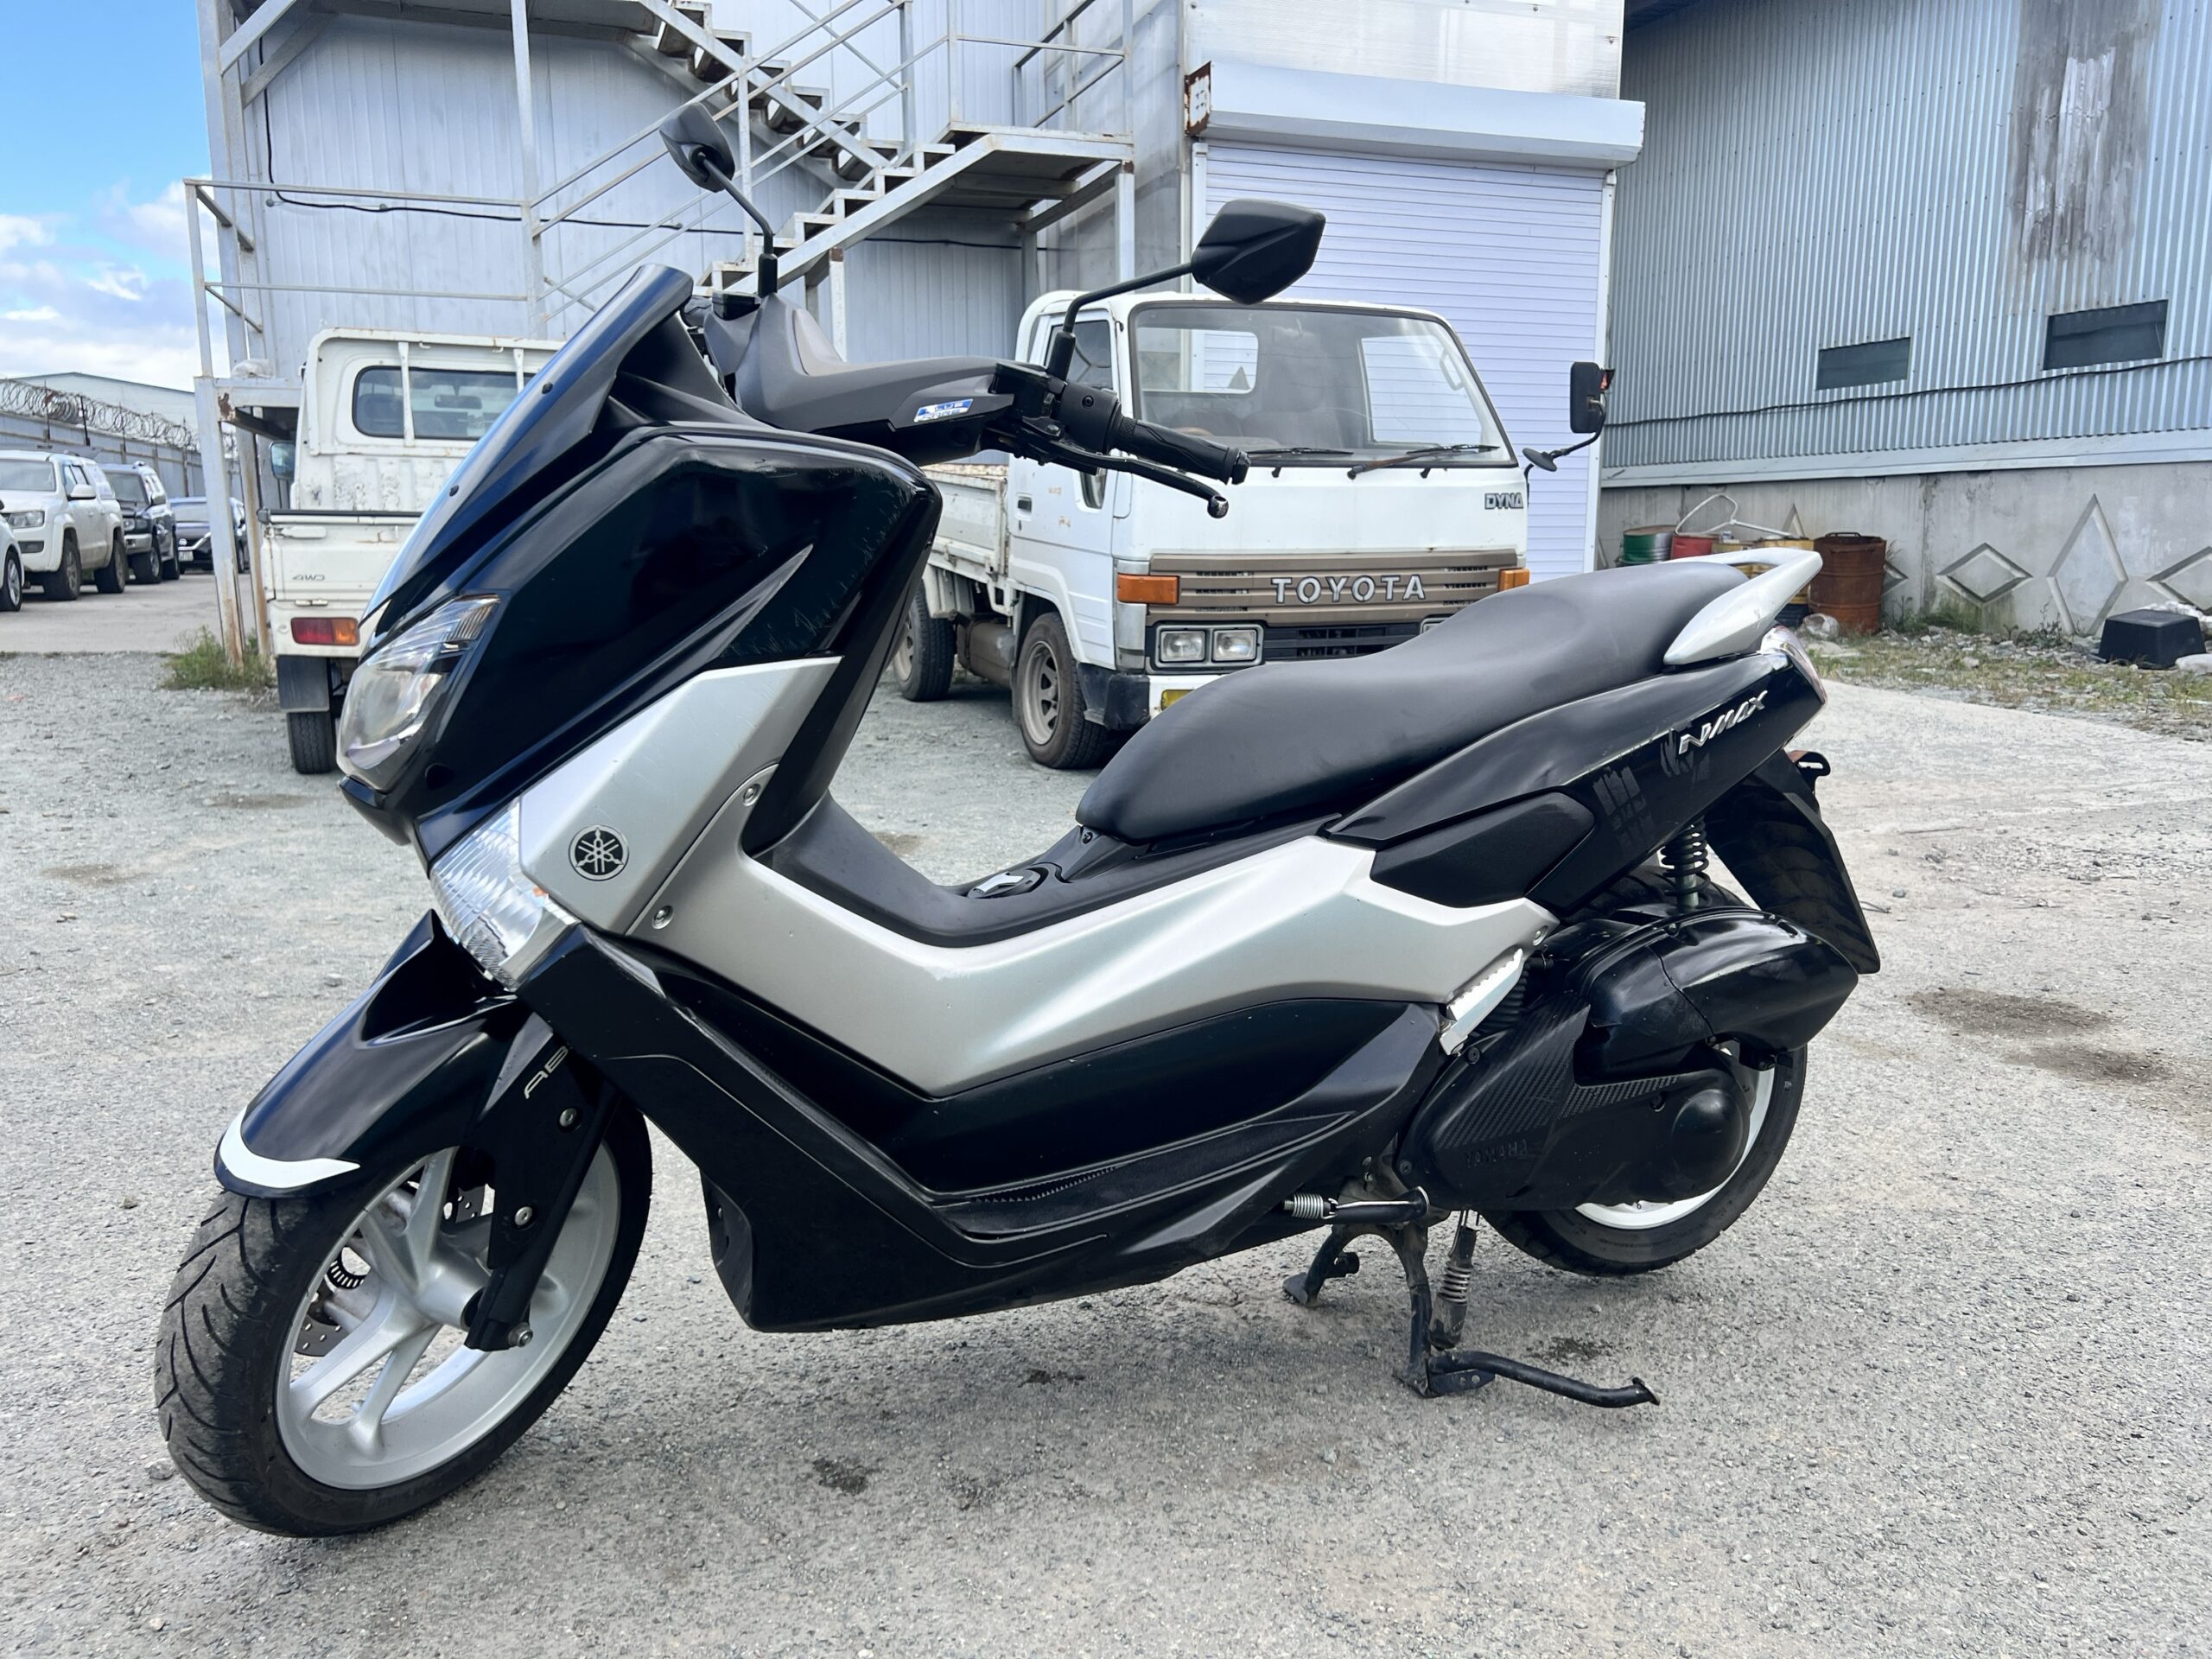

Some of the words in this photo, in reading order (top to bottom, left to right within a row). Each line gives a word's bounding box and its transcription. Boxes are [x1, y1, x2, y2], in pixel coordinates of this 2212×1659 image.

[1484, 493, 1523, 510] DYNA
[1270, 575, 1426, 604] TOYOTA
[1678, 690, 1768, 755] NMAX
[1464, 1137, 1528, 1168] YAMAHA
